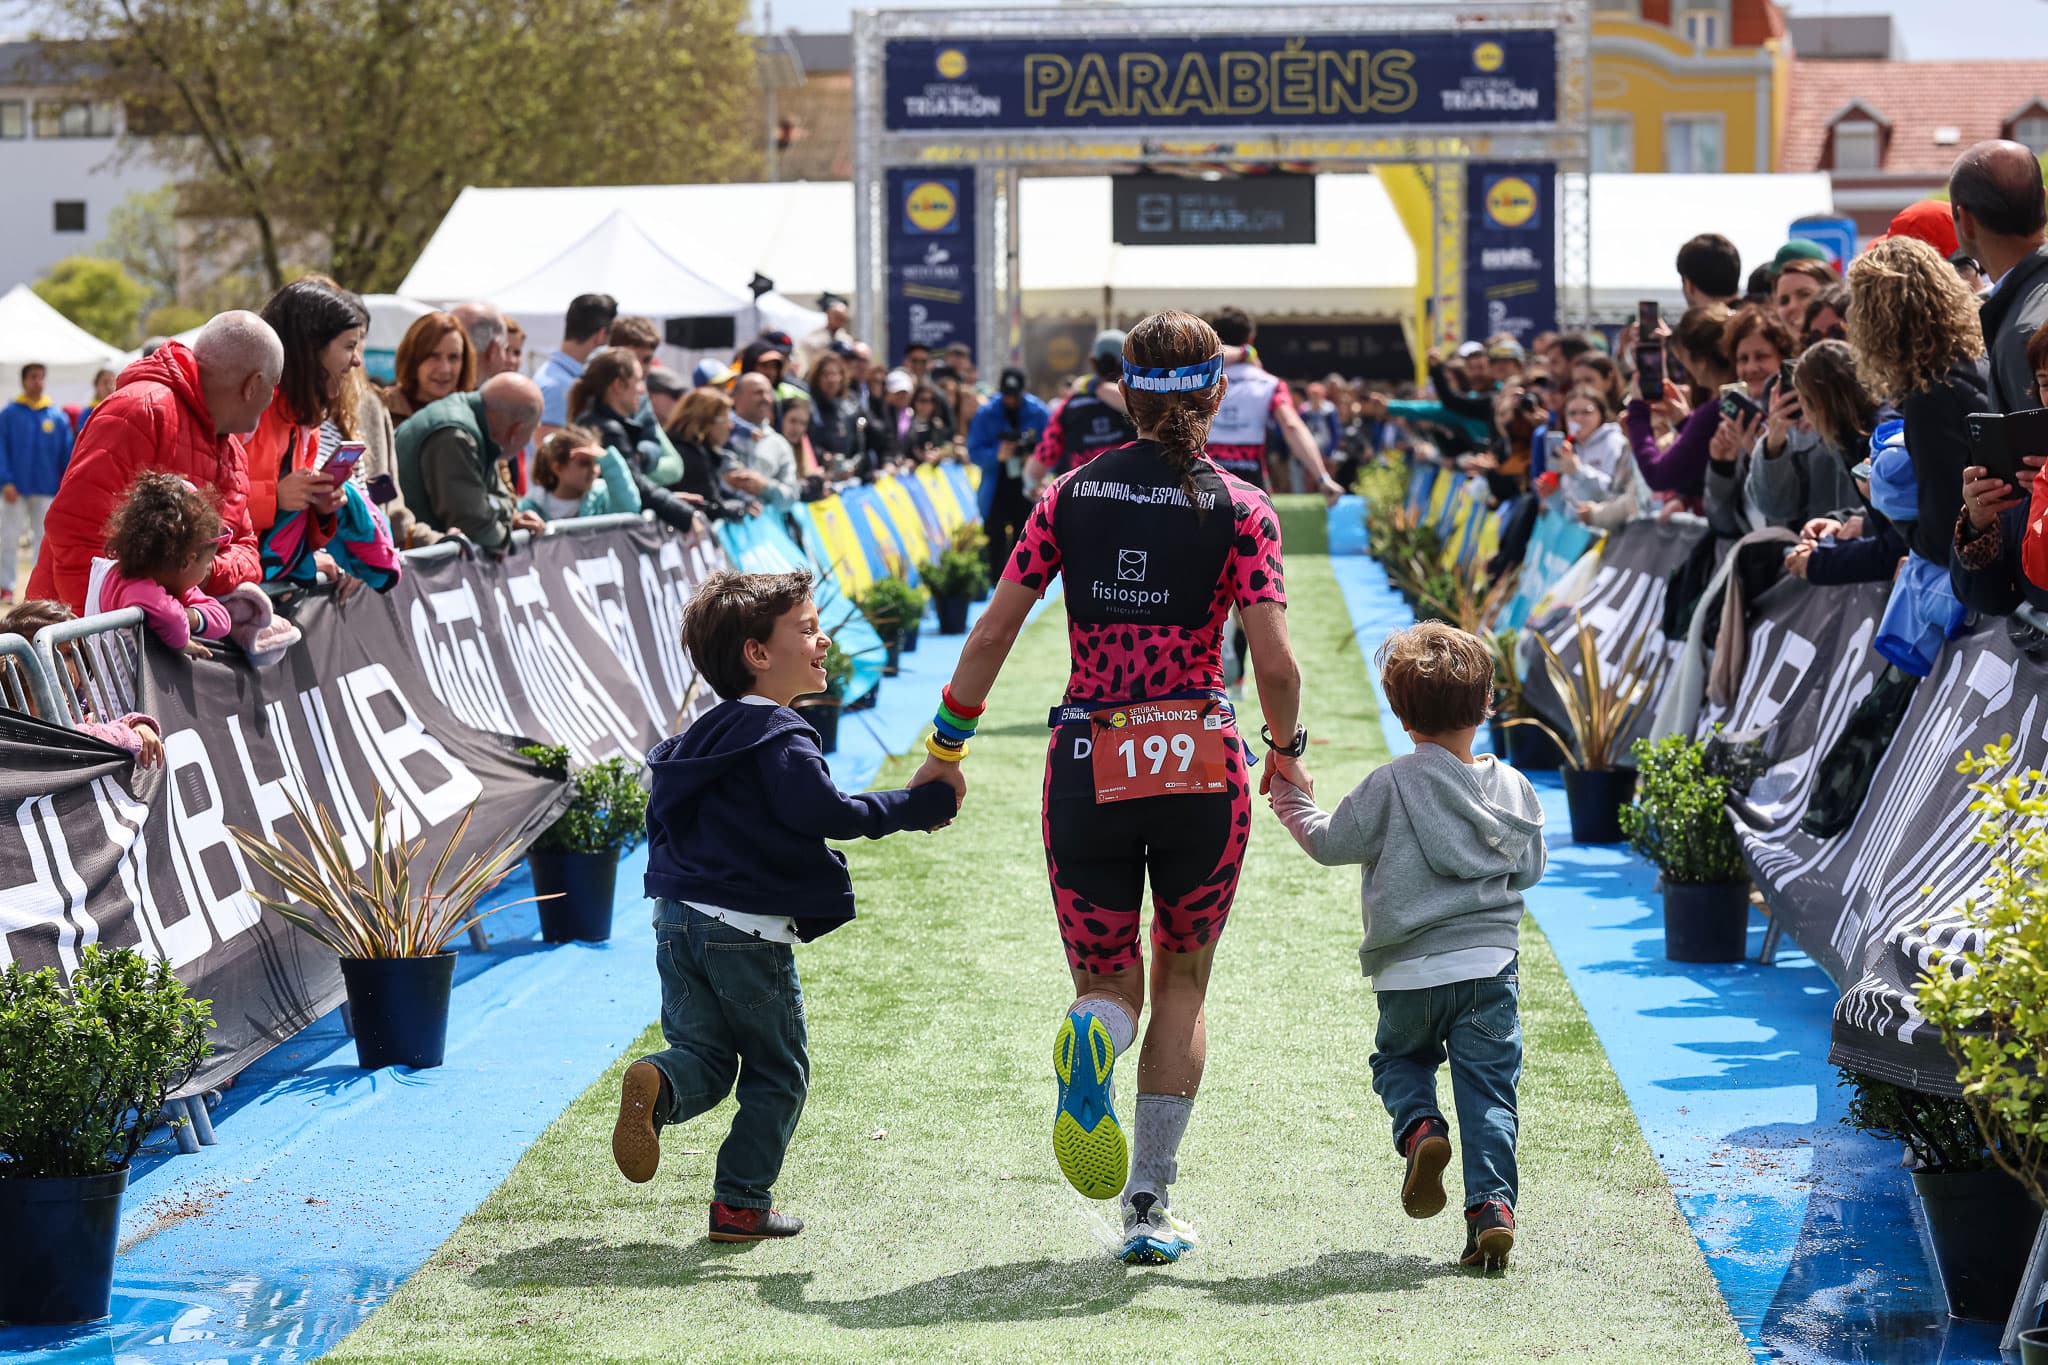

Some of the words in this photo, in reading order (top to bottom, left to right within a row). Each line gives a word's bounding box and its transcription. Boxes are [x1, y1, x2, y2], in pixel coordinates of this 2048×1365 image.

[1024, 37, 1419, 117] PARABÉNS
[1132, 373, 1203, 391] IRONMAN
[1072, 482, 1080, 497] A
[1080, 481, 1130, 501] GINJINHA
[1150, 487, 1216, 510] ESPINIRA
[1092, 581, 1170, 606] fisiospot
[1129, 705, 1160, 716] SETÚBAL
[1118, 733, 1196, 778] 199
